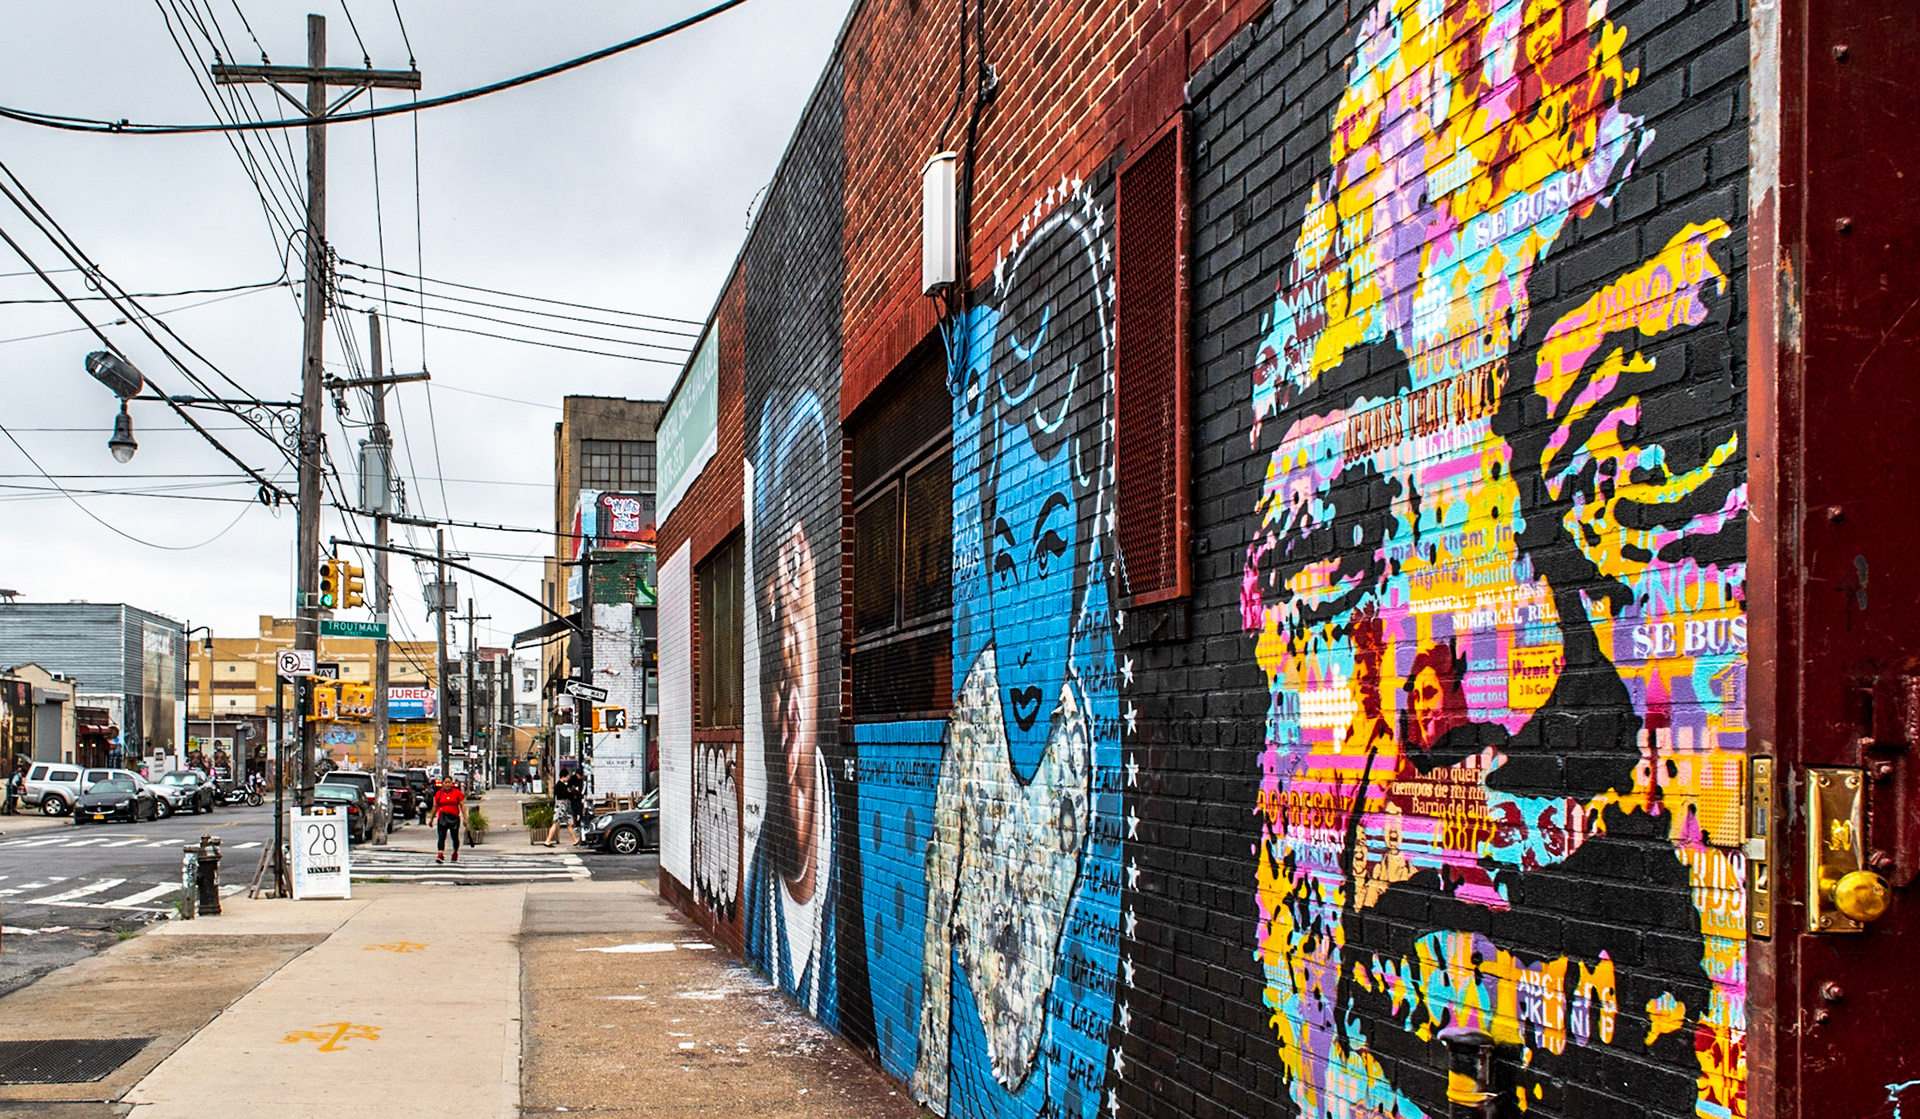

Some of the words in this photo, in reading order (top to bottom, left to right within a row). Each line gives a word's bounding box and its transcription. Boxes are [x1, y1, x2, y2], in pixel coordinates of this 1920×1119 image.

[1476, 209, 1507, 249] SE
[1513, 163, 1595, 230] BUSCA
[1343, 399, 1403, 464] ACROSS
[1405, 379, 1453, 441] THAT
[1443, 528, 1484, 551] them
[1409, 594, 1471, 614] NUMERICAL
[1475, 582, 1547, 607] RELATIONS
[327, 621, 380, 632] TROUTMAN
[1452, 607, 1522, 629] NUMERICAL
[1632, 622, 1677, 658] SE
[389, 689, 435, 699] JURED?
[307, 823, 337, 856] 28
[1072, 907, 1120, 949] DREAM
